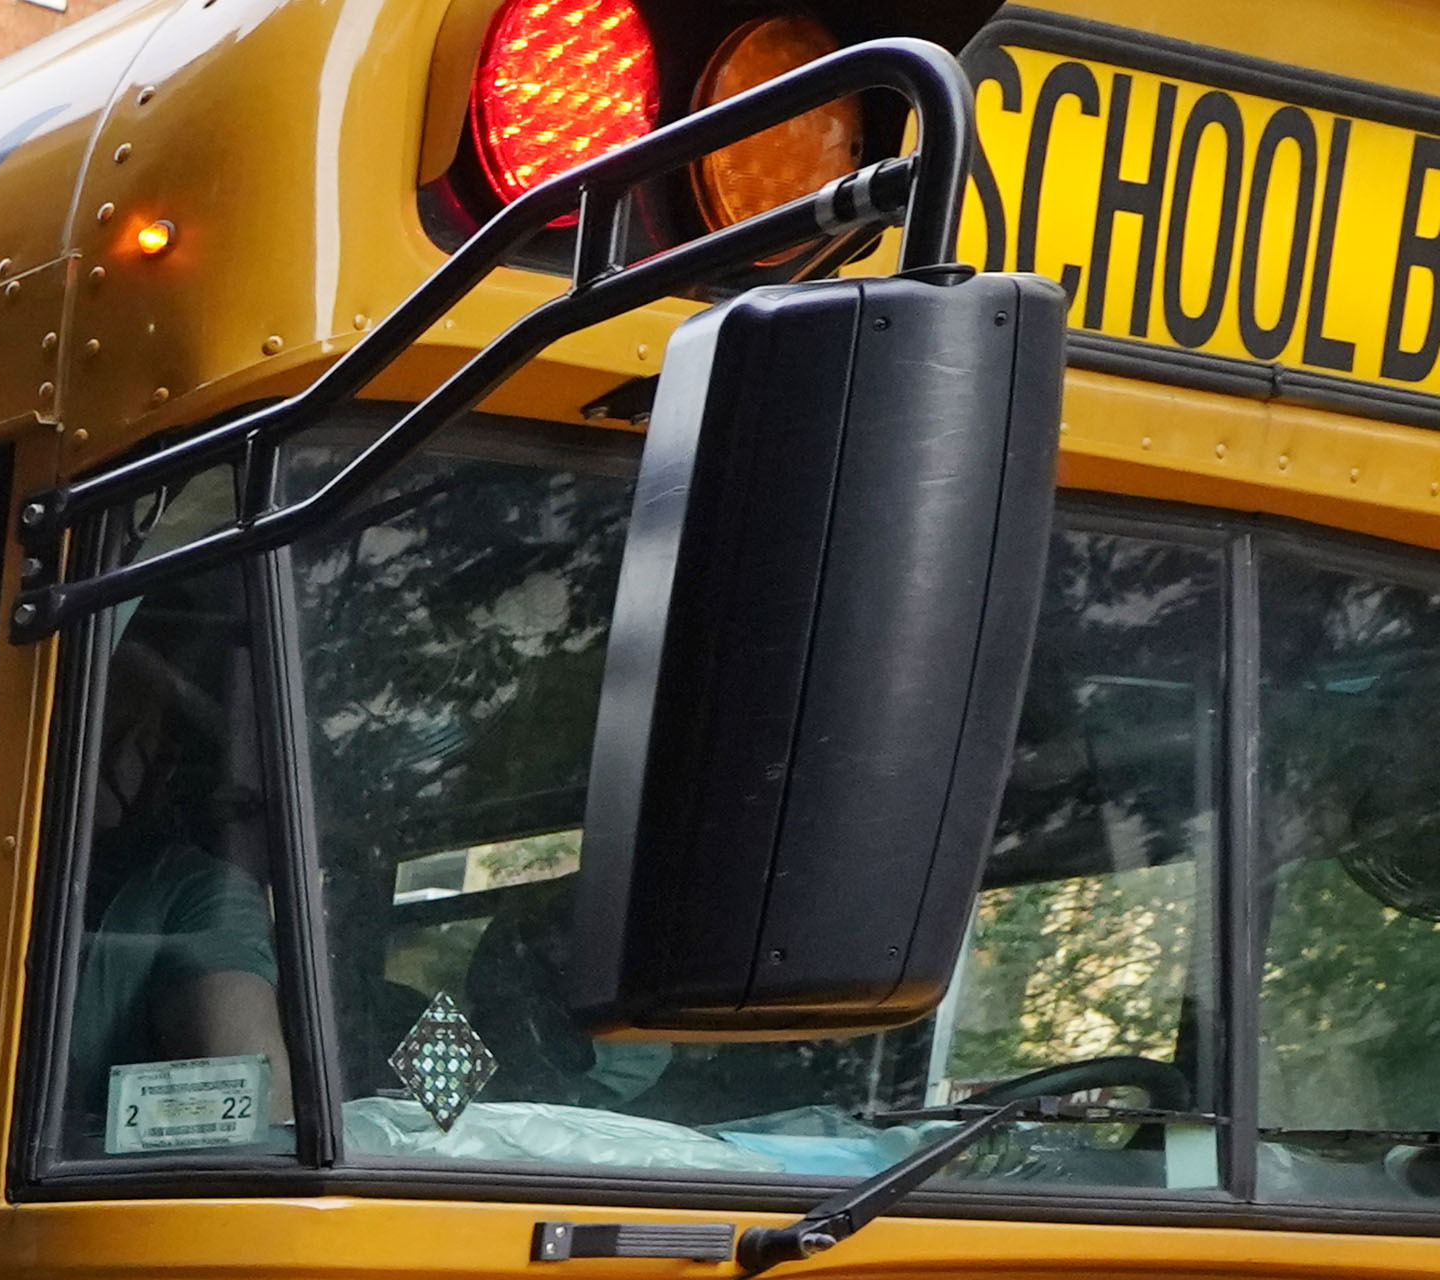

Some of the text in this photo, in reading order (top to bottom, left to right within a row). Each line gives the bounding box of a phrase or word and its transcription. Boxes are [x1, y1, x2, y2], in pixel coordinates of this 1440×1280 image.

[968, 45, 1357, 373] SCHOOL
[126, 1095, 252, 1127] 2 22
